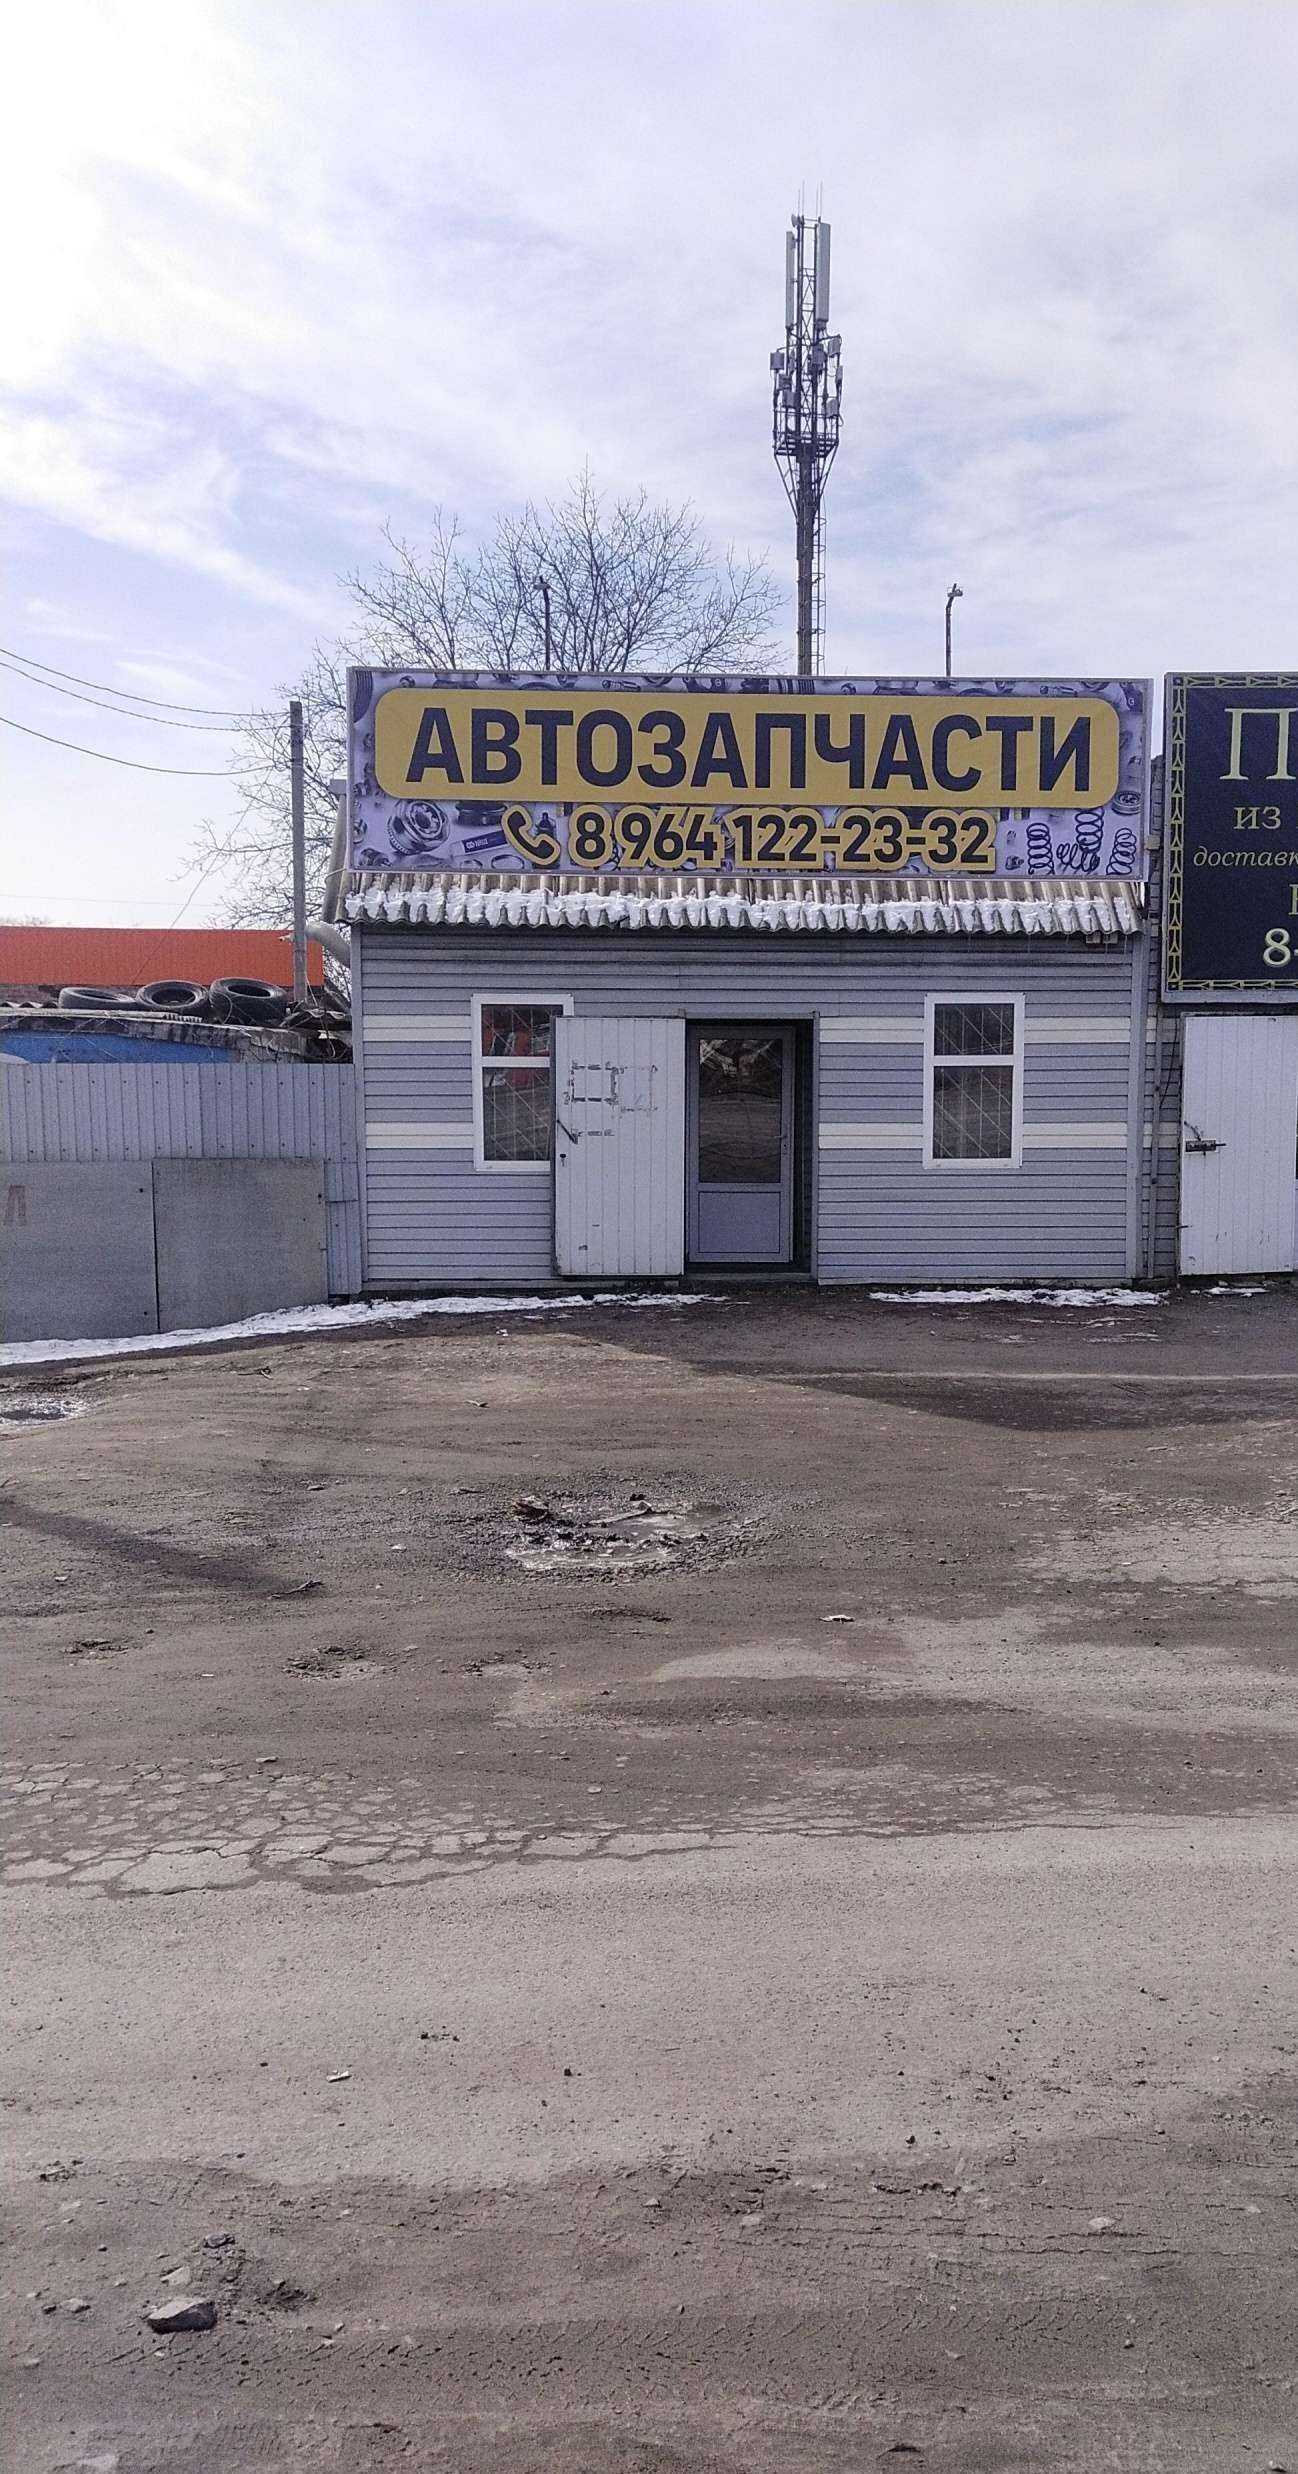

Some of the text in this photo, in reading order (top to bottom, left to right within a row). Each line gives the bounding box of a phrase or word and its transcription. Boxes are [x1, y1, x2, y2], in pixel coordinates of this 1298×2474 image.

[405, 707, 1091, 792] АВТОЗАПЧАСТИ
[575, 812, 991, 865] 8 964 122-23-32
[1233, 806, 1281, 830] из
